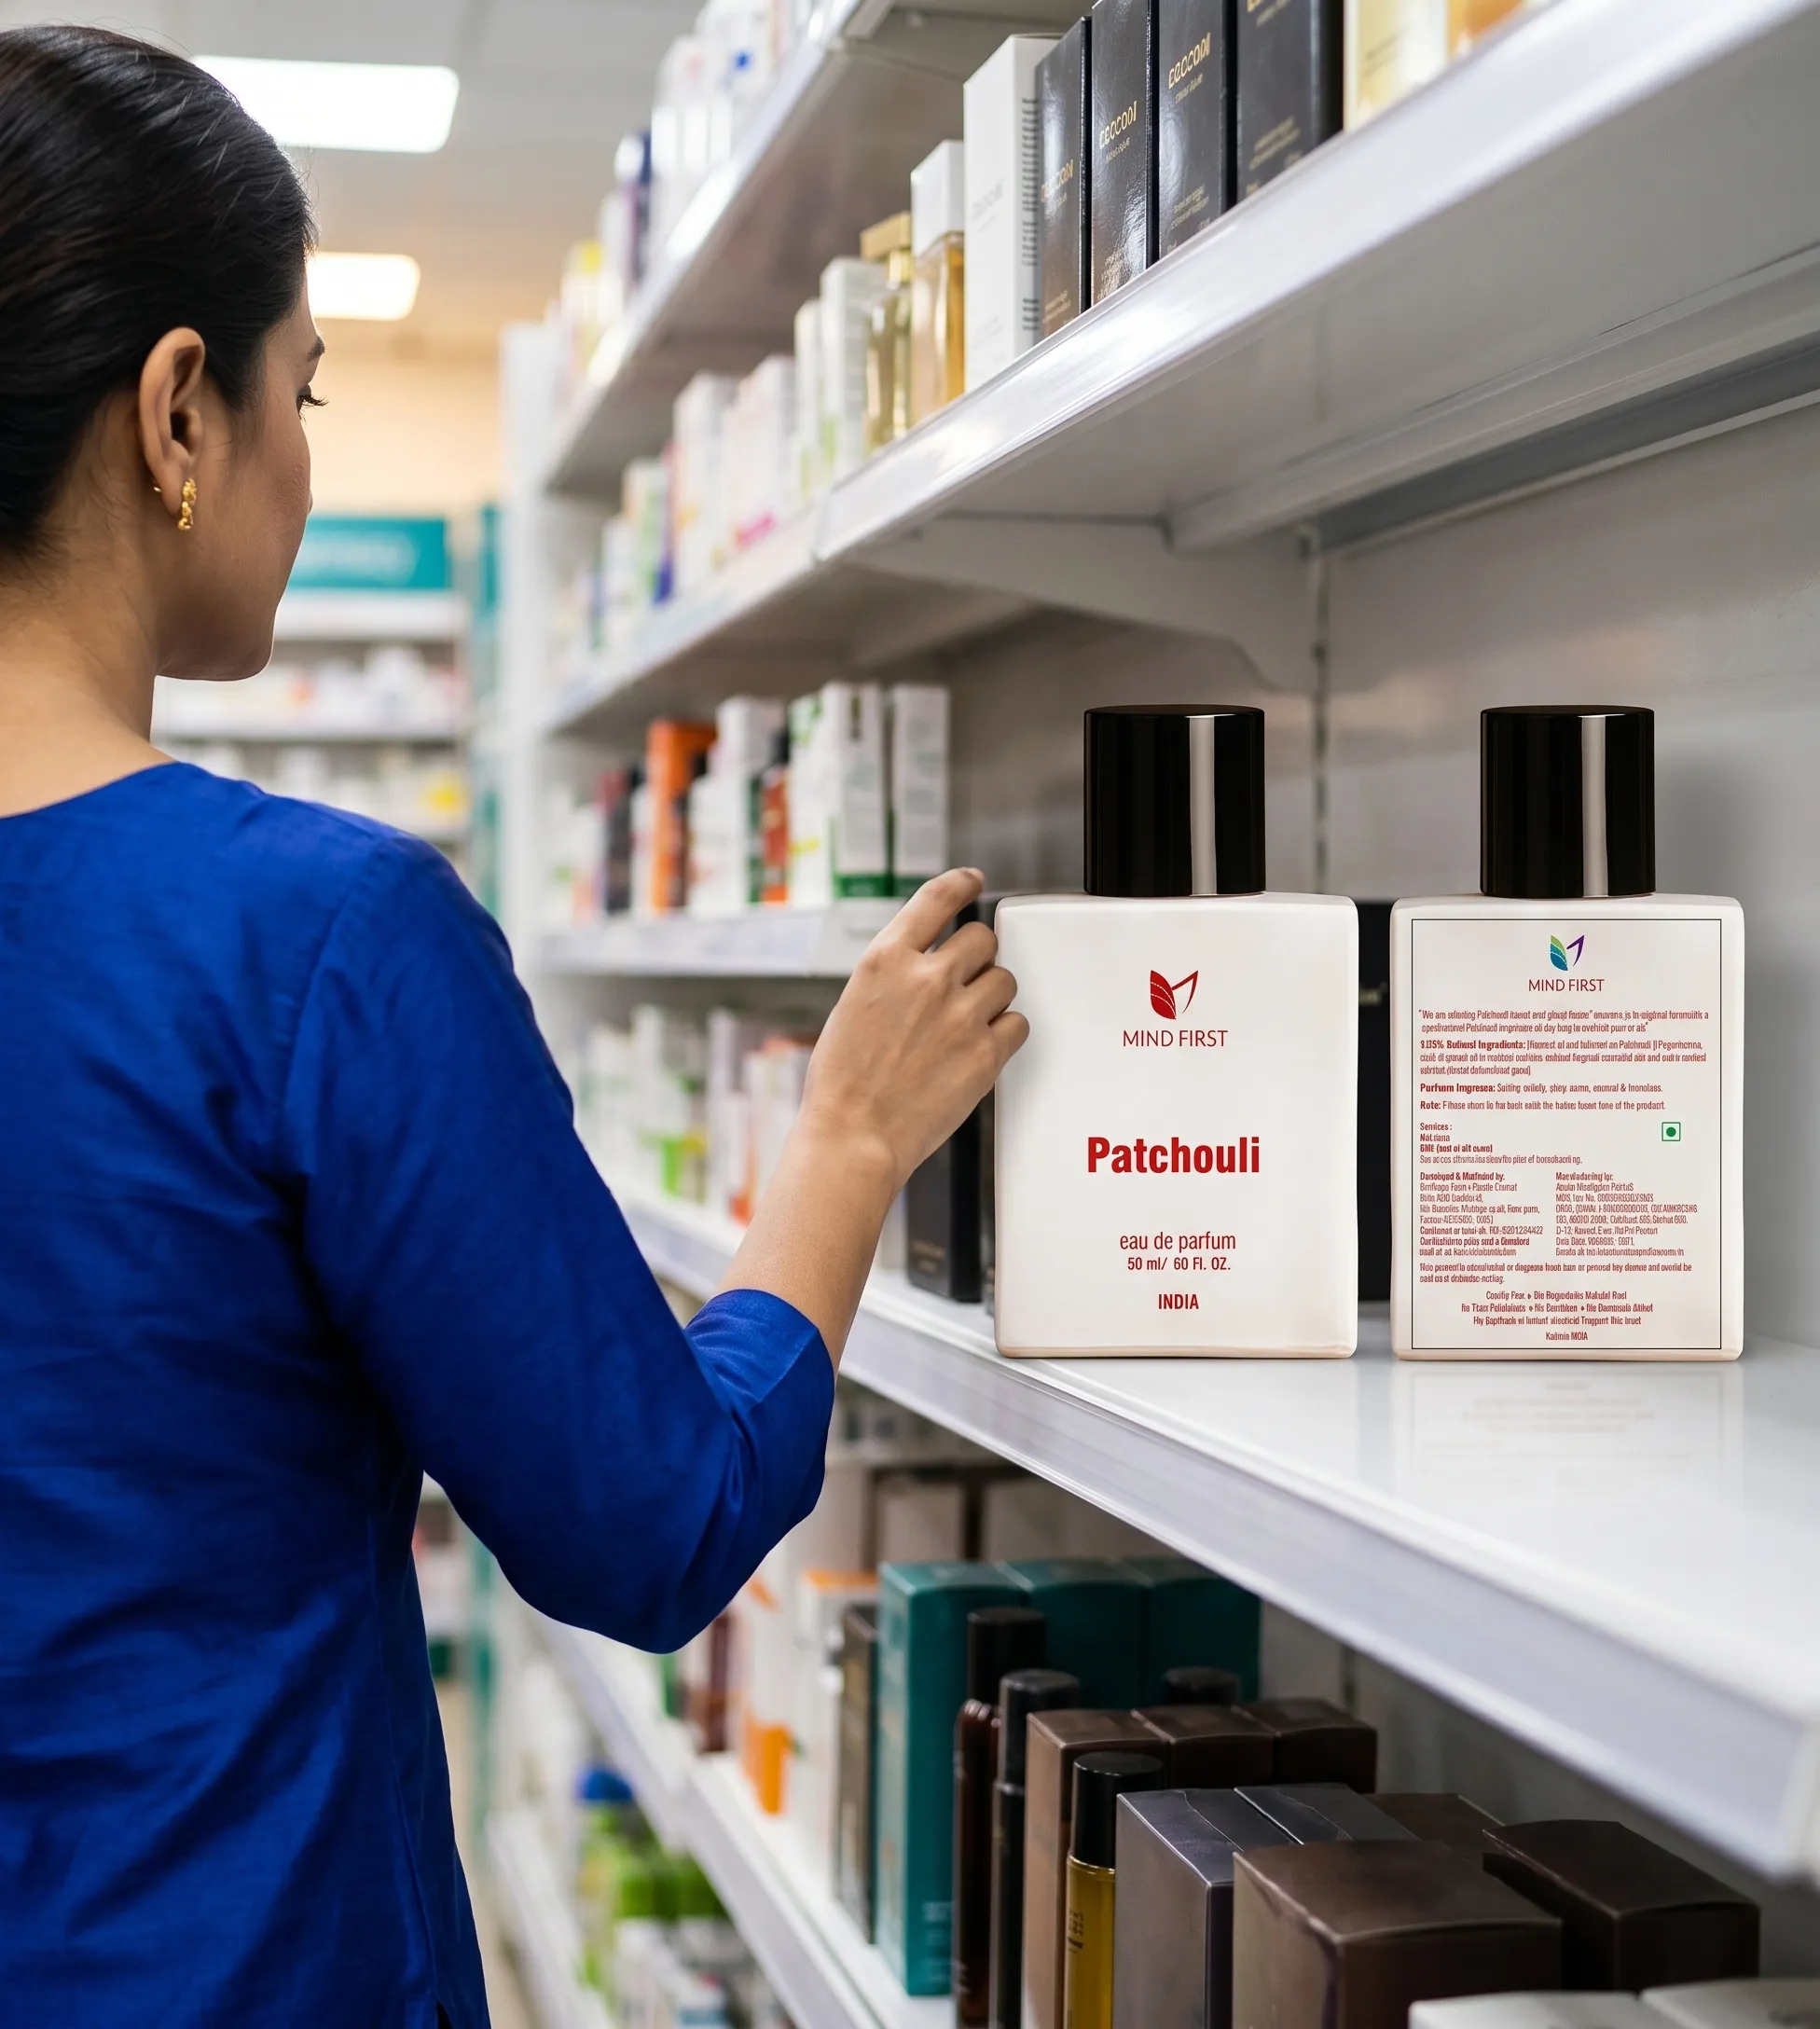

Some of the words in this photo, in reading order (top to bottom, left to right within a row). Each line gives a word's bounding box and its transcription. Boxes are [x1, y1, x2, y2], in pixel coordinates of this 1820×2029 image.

[1529, 979, 1565, 991] MIND
[1569, 979, 1605, 991] FIRST
[1124, 1030, 1173, 1046] MIND
[1179, 1030, 1228, 1046] FIRST
[1543, 1101, 1553, 1110] the
[1624, 1101, 1634, 1110] the
[1088, 1137, 1259, 1173] Patchouli
[1120, 1235, 1148, 1249] eau
[1154, 1232, 1173, 1249] de
[1179, 1232, 1235, 1253] parfum
[1128, 1257, 1142, 1270] 50
[1147, 1257, 1167, 1270] ml/
[1174, 1257, 1188, 1270] 60
[1193, 1257, 1206, 1270] Fl.
[1211, 1257, 1230, 1270] OZ.
[1159, 1294, 1199, 1309] INDIA
